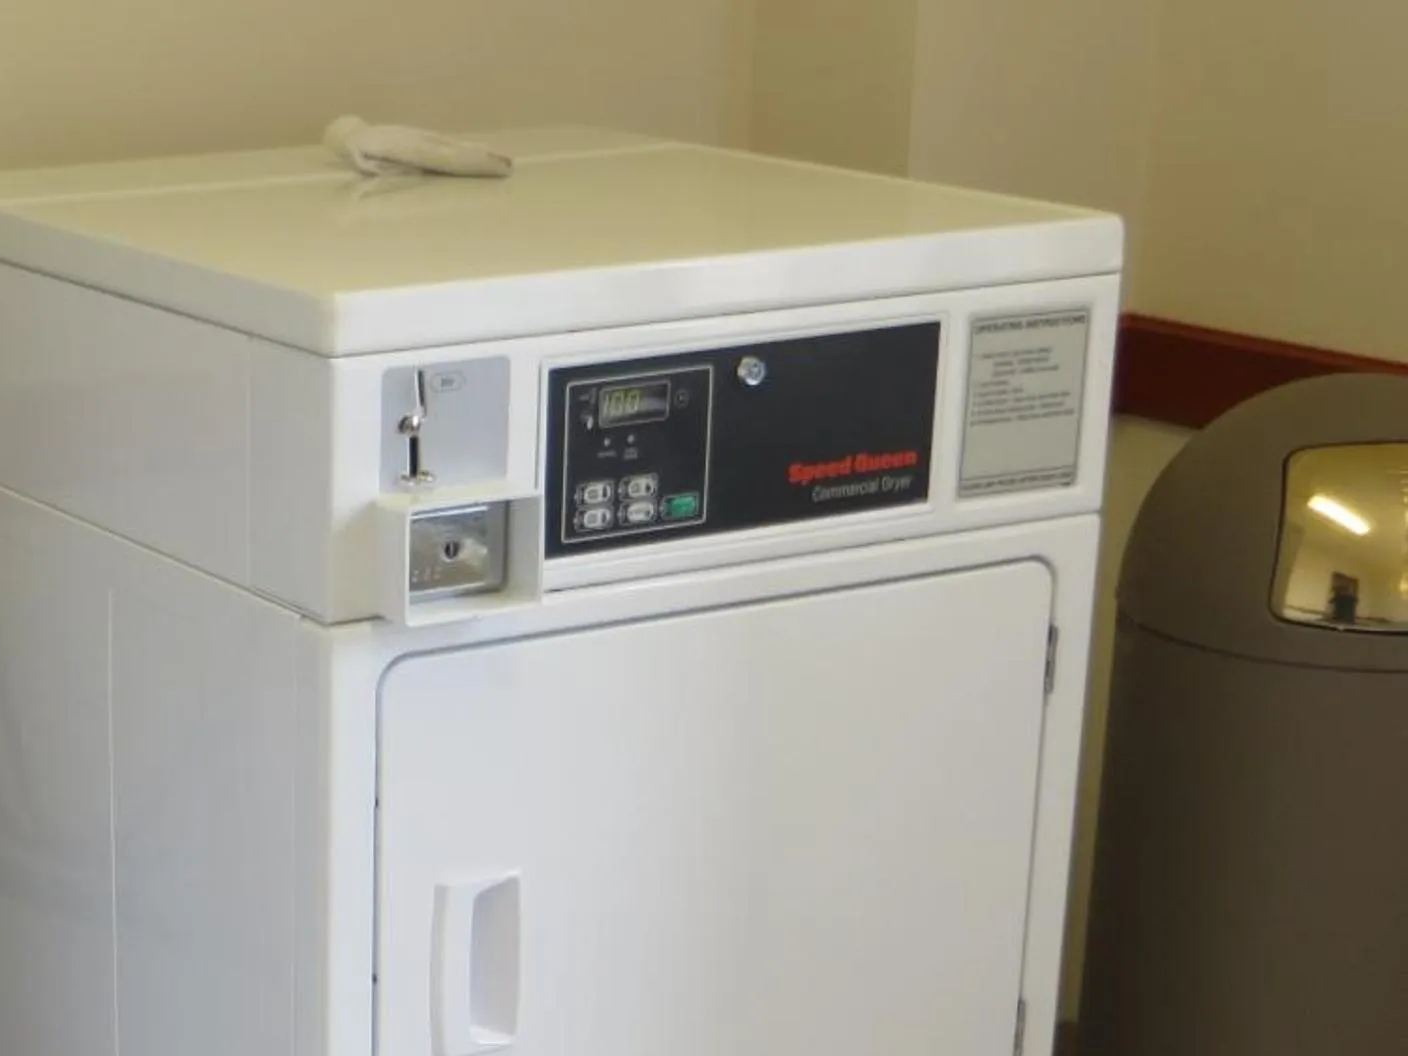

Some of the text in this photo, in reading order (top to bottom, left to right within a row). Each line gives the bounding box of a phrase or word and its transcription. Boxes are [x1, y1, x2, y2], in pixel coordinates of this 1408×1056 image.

[787, 451, 918, 486] Speed Queen
[812, 474, 913, 502] Commercial Dryer
